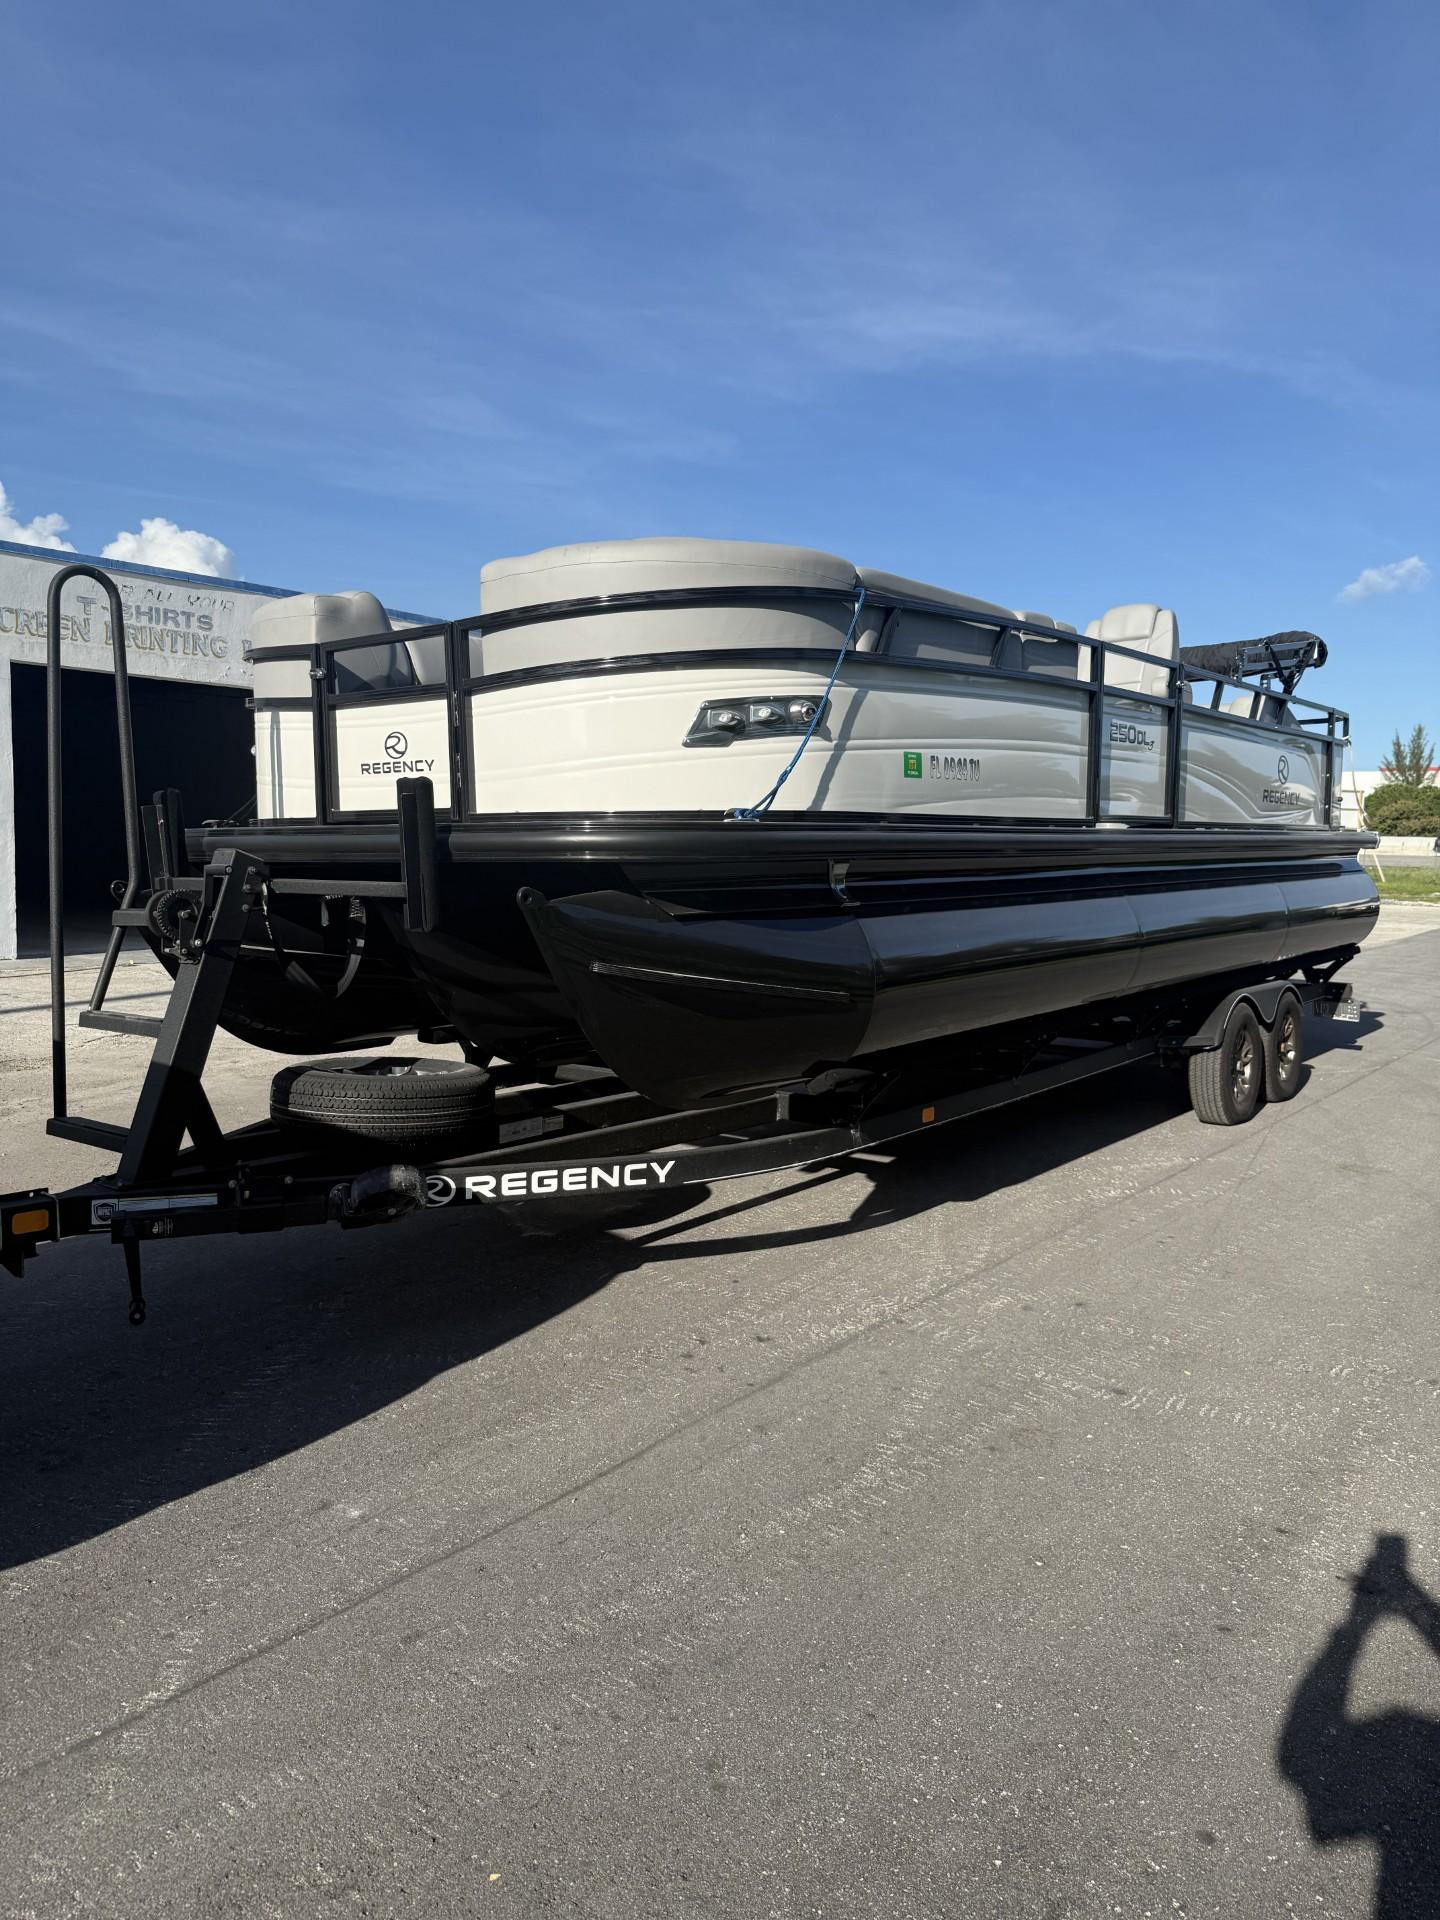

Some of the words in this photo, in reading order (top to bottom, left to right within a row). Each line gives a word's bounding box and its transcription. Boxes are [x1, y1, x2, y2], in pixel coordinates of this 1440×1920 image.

[361, 760, 434, 774] REGENCY
[930, 755, 942, 779] FL
[1262, 789, 1300, 806] REGENCY
[465, 1160, 676, 1200] REGENCY
